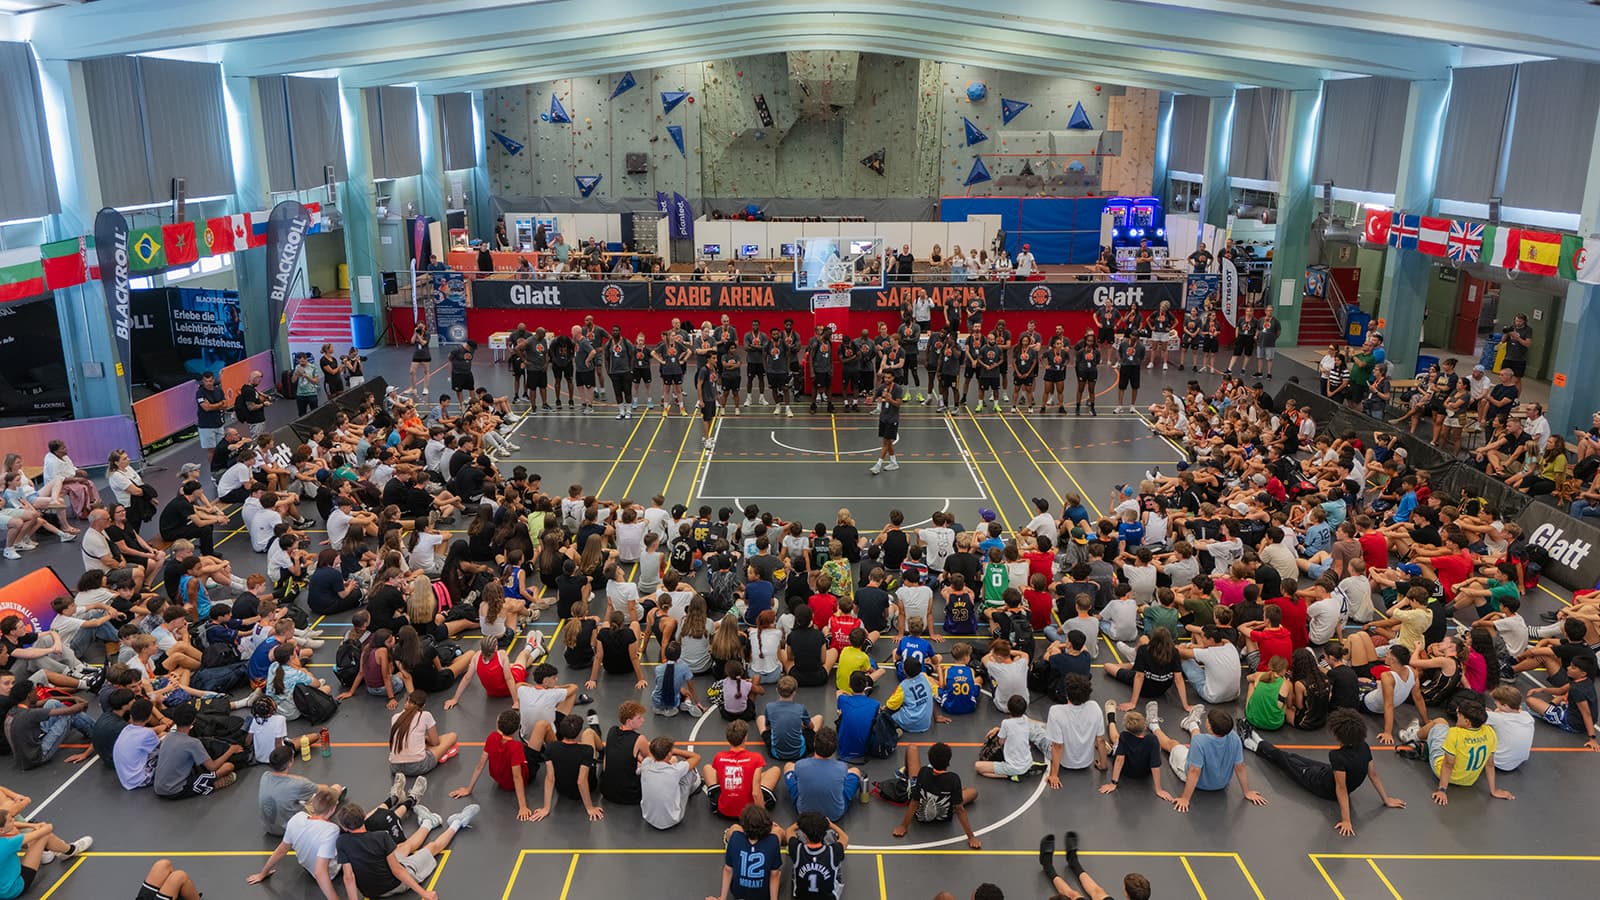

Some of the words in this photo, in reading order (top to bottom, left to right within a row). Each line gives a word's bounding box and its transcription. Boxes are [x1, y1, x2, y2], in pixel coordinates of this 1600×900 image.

[271, 218, 306, 301] BLACKROLL
[115, 231, 129, 340] BLACKROLL
[510, 284, 561, 305] Glatt
[665, 285, 711, 306] SABC
[719, 286, 775, 306] ARENA
[1093, 286, 1144, 306] Glatt
[173, 309, 200, 320] Erlebe
[202, 311, 215, 321] die
[175, 322, 224, 335] Leichtigkeit
[177, 335, 192, 345] des
[193, 335, 244, 349] Aufstehens.
[1319, 528, 1329, 541] 12
[674, 548, 686, 561] 34
[1528, 522, 1592, 570] Glatt
[992, 573, 1002, 587] 0
[951, 608, 969, 622] 23
[909, 683, 927, 701] 12
[952, 683, 970, 695] 30
[1465, 744, 1487, 771] 10
[739, 850, 766, 878] 12
[808, 873, 819, 892] 1
